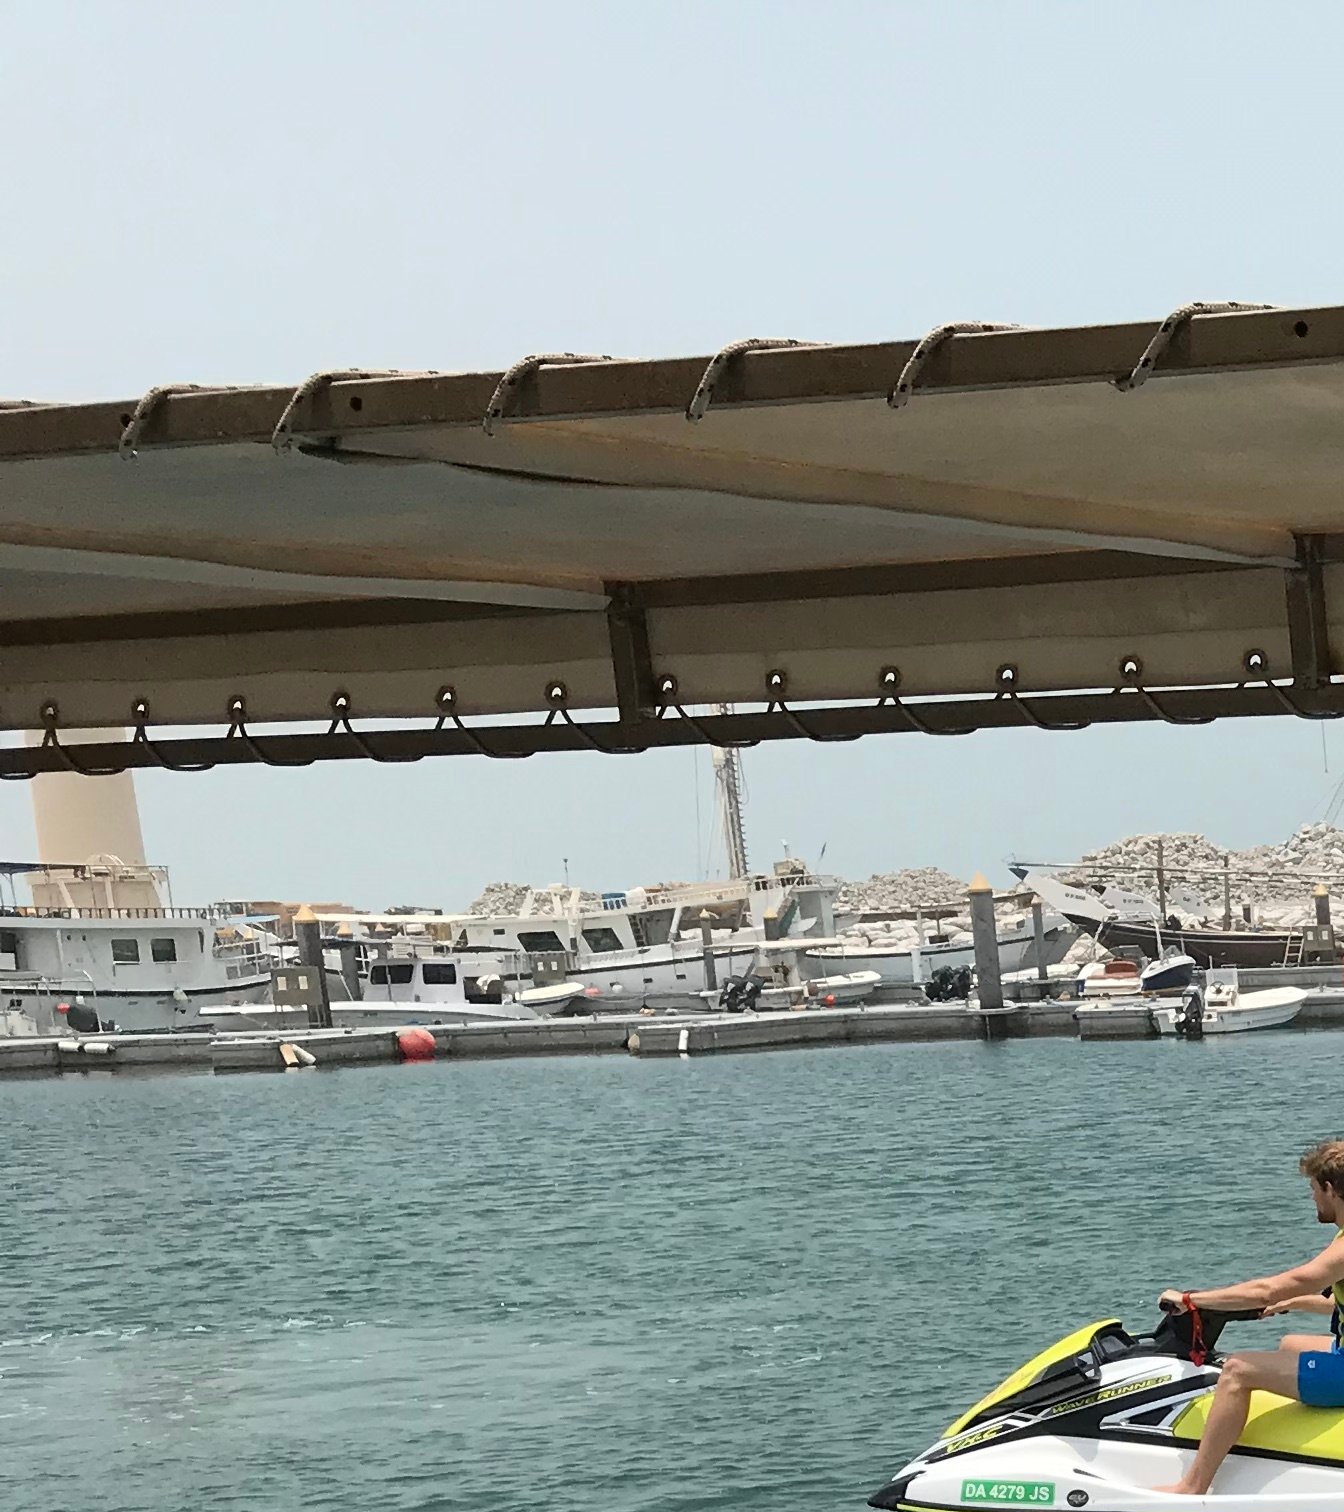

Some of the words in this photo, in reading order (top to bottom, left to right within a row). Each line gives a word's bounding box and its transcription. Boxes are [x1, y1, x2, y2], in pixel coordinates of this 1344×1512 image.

[965, 1483, 986, 1499] DA
[990, 1484, 1025, 1500] 4279
[1028, 1485, 1050, 1502] JS
